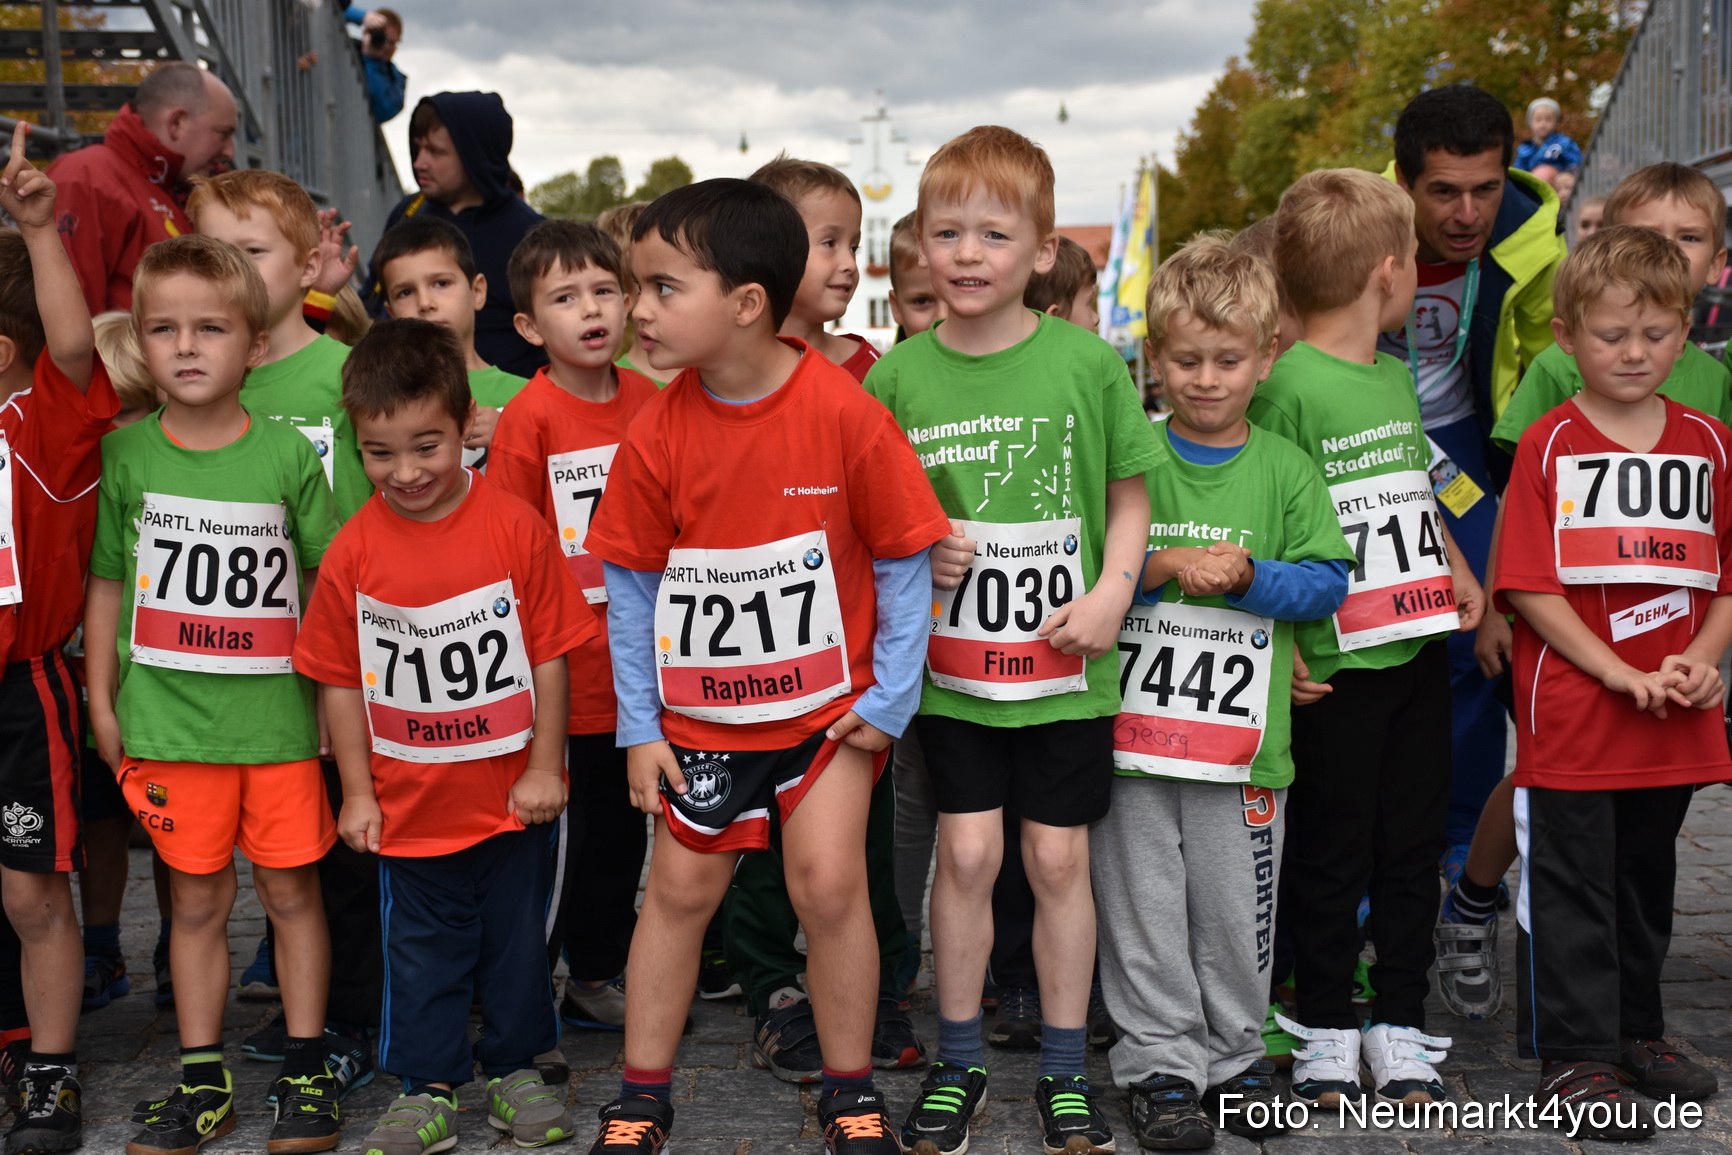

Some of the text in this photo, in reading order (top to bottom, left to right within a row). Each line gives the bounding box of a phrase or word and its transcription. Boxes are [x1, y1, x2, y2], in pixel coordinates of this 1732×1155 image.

[907, 414, 1024, 446] Neumarkter
[1321, 419, 1413, 455] Neumarkter
[554, 463, 609, 484] PARTL
[1324, 442, 1404, 479] Stadtlauf
[784, 485, 839, 496] FC Holzheim
[1578, 457, 1712, 524] 7000
[1334, 496, 1376, 517] RTL
[144, 511, 195, 532] PARTL
[199, 517, 279, 537] Neumarkt
[1149, 520, 1232, 541] markter
[986, 540, 1059, 559] Neumarkt
[1617, 535, 1687, 562] Lukas
[153, 538, 288, 609] 7082
[663, 558, 797, 584] PARTL Neumarkt
[948, 564, 1074, 633] 7039
[1392, 586, 1456, 617] Kilian
[362, 608, 489, 639] PARTL Neumarkt
[669, 579, 817, 658] 7217
[1635, 602, 1671, 627] DEHN
[178, 621, 254, 651] Niklas
[1119, 616, 1244, 645] RTL Neumarkt
[376, 629, 516, 704] 7192
[984, 650, 1035, 676] Finn
[701, 667, 804, 705] Raphael
[1117, 641, 1255, 718] 7442
[406, 714, 491, 742] Patrick
[1112, 718, 1188, 760] Georg
[138, 810, 175, 832] FCB
[1250, 826, 1273, 974] FIGHTER
[1290, 1025, 1313, 1037] LICO
[1413, 1034, 1436, 1044] LICO
[300, 1086, 323, 1096] LICO
[935, 1074, 961, 1083] LICO
[1064, 1082, 1089, 1091] LICO
